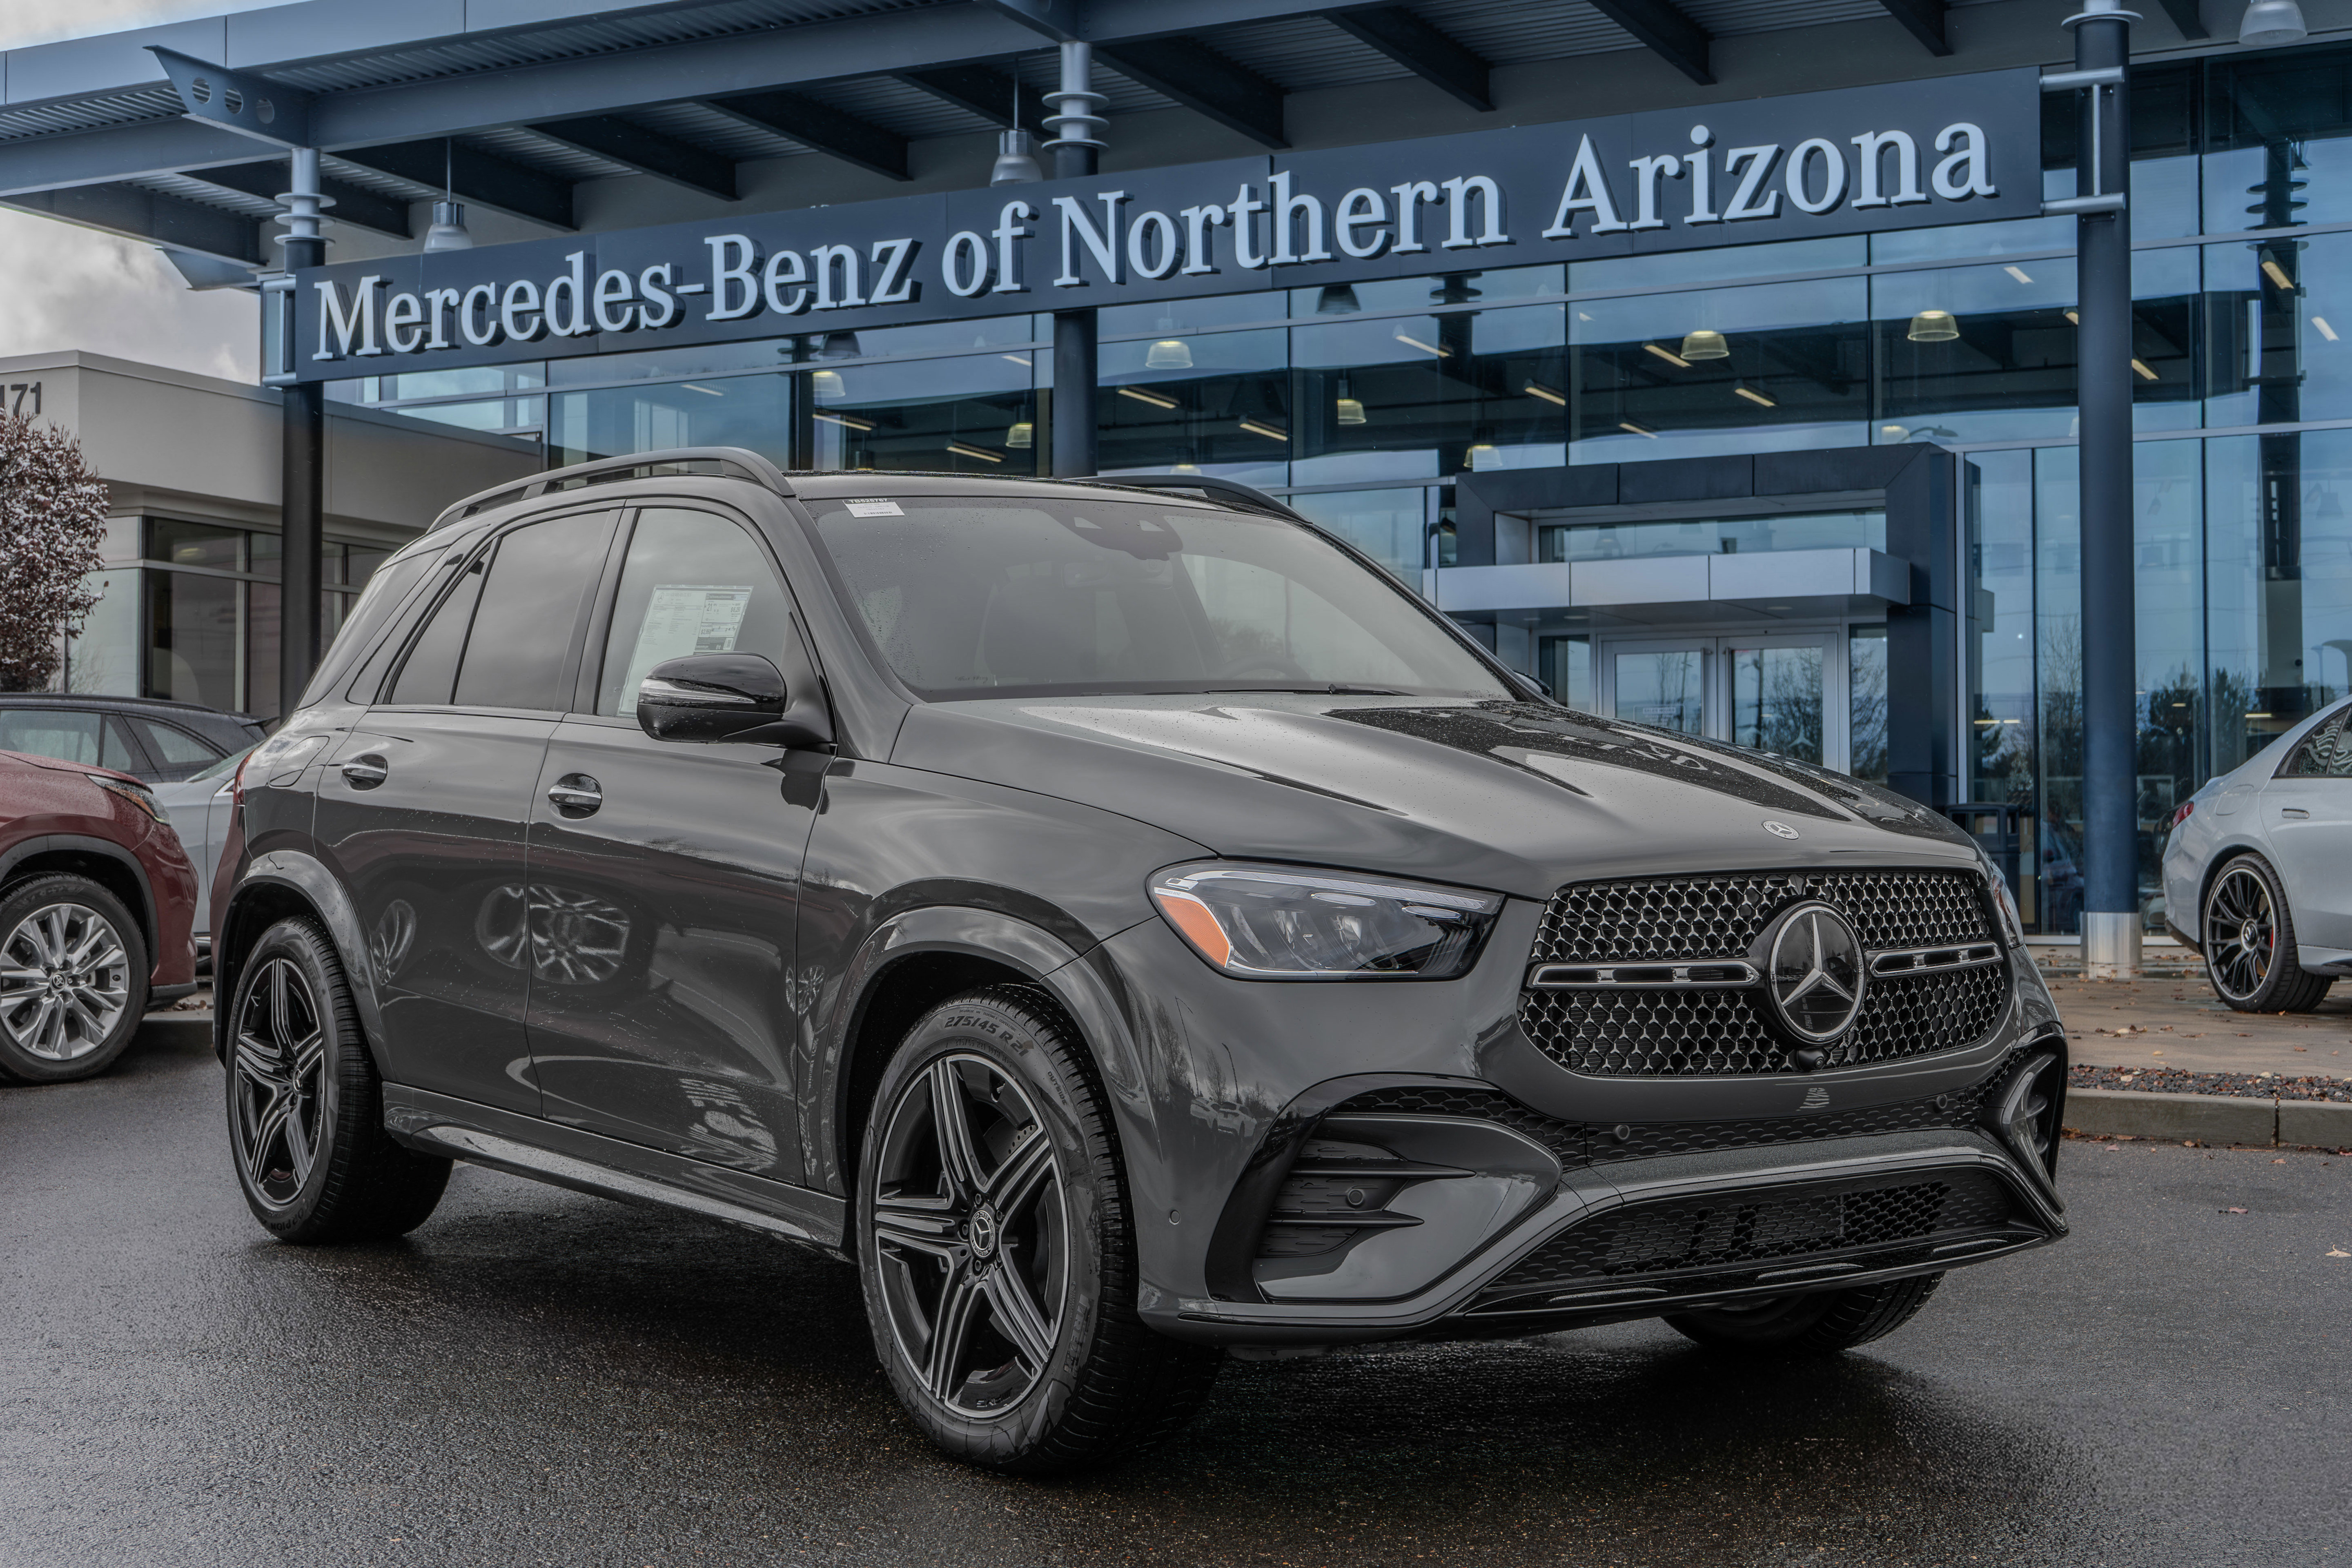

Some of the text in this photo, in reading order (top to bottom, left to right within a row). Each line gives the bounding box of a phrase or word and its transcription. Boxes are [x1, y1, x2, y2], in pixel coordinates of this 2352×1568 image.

[312, 122, 2000, 361] Mercedes-Benz of Northern Arizona
[944, 1016, 1029, 1057] 275/45 R 21
[1048, 1071, 1068, 1106] OUTSIDE
[979, 1212, 989, 1221] BENZ
